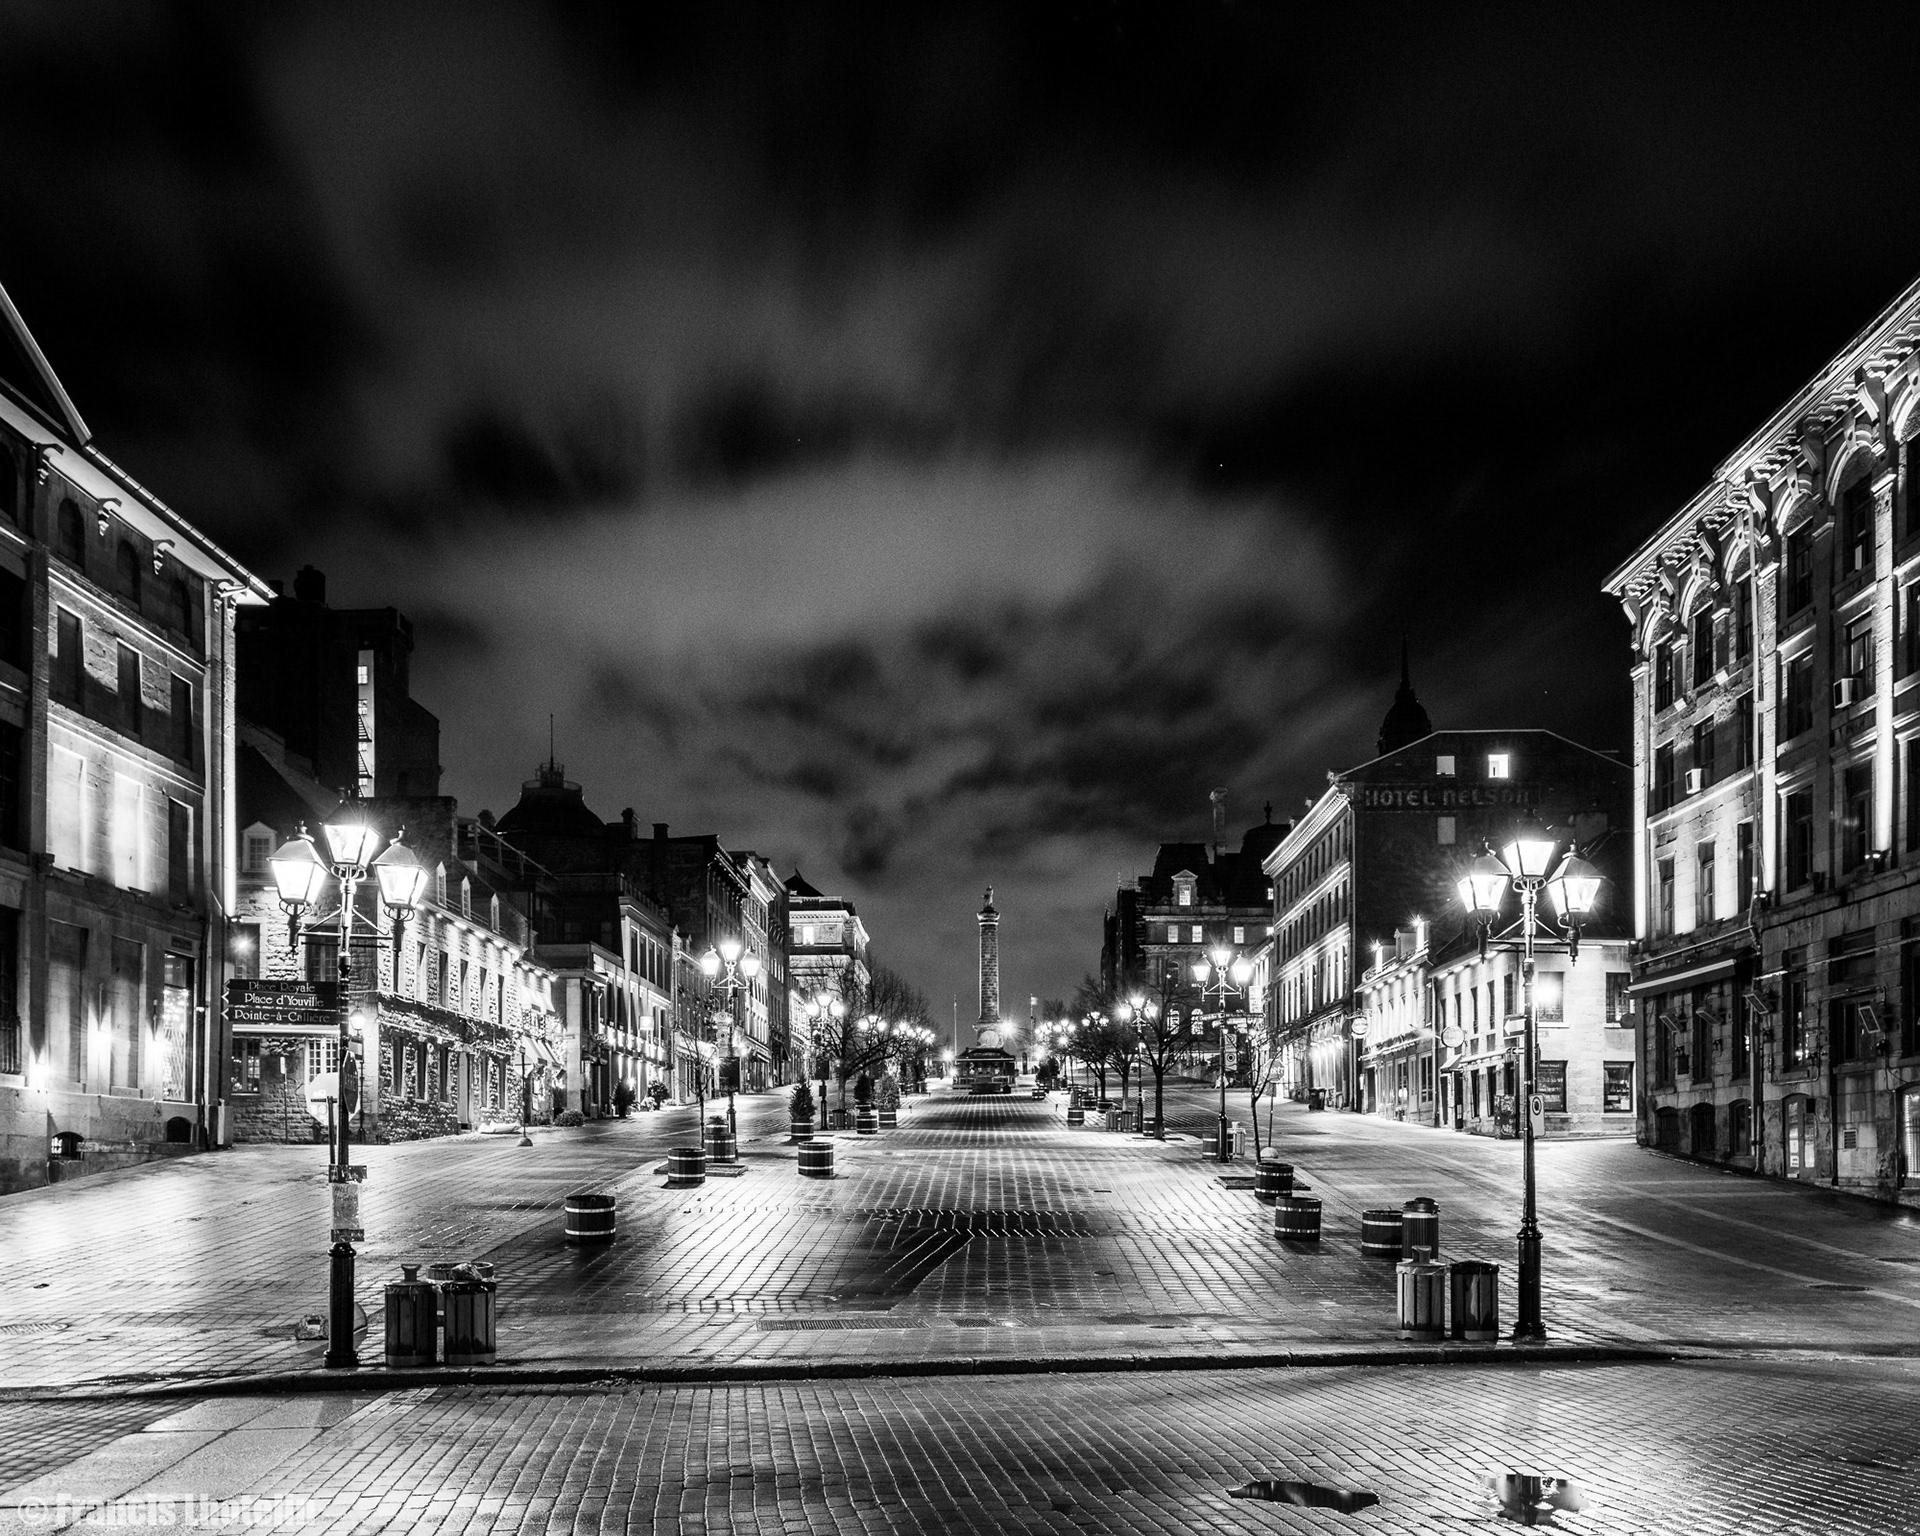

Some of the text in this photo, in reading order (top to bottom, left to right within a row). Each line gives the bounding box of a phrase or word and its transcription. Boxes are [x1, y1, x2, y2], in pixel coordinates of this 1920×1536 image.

[1365, 788, 1435, 807] HOTEL
[248, 981, 316, 994] Place Royale
[244, 993, 325, 1007] Place d'Youville
